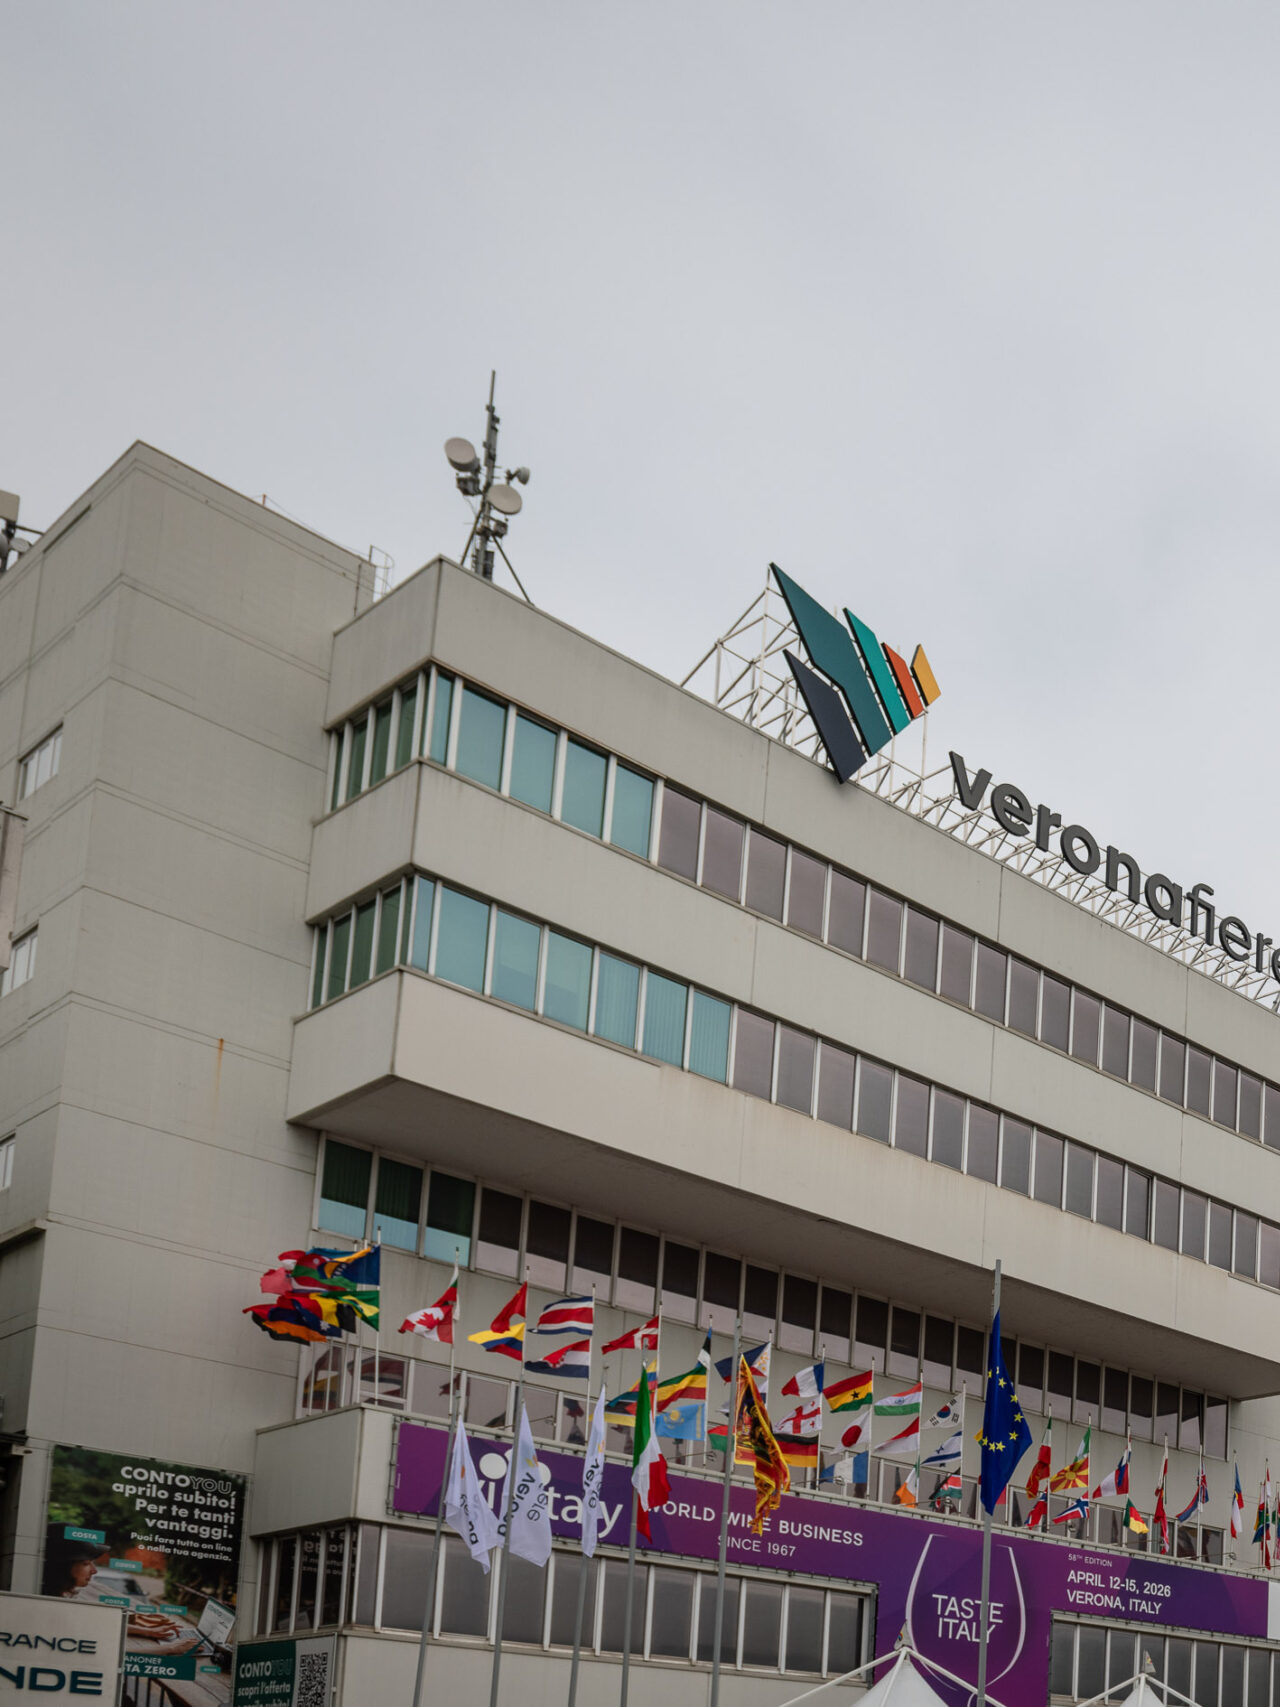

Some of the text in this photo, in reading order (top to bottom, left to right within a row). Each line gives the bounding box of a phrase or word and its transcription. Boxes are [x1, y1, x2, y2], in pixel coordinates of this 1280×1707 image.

[112, 1483, 236, 1509] aprilo subito!
[135, 1498, 235, 1524] Per te tanti
[72, 1531, 98, 1540] COSTA
[145, 1518, 233, 1540] vantaggi.
[779, 1520, 864, 1546] BUSINESS
[130, 1532, 152, 1542] Puoi
[154, 1535, 175, 1545] fare
[177, 1539, 199, 1548] tutto
[215, 1543, 233, 1552] line
[767, 1542, 796, 1557] 1967
[147, 1545, 171, 1554] nella
[173, 1548, 189, 1556] tua
[191, 1552, 232, 1561] agenzia.
[1084, 1556, 1112, 1568] EDITION
[1067, 1570, 1171, 1598] APRIL 12-15, 2026
[1066, 1589, 1162, 1615] VERONA, ITALY
[144, 1665, 177, 1676] ZERO
[237, 1681, 260, 1699] scopri
